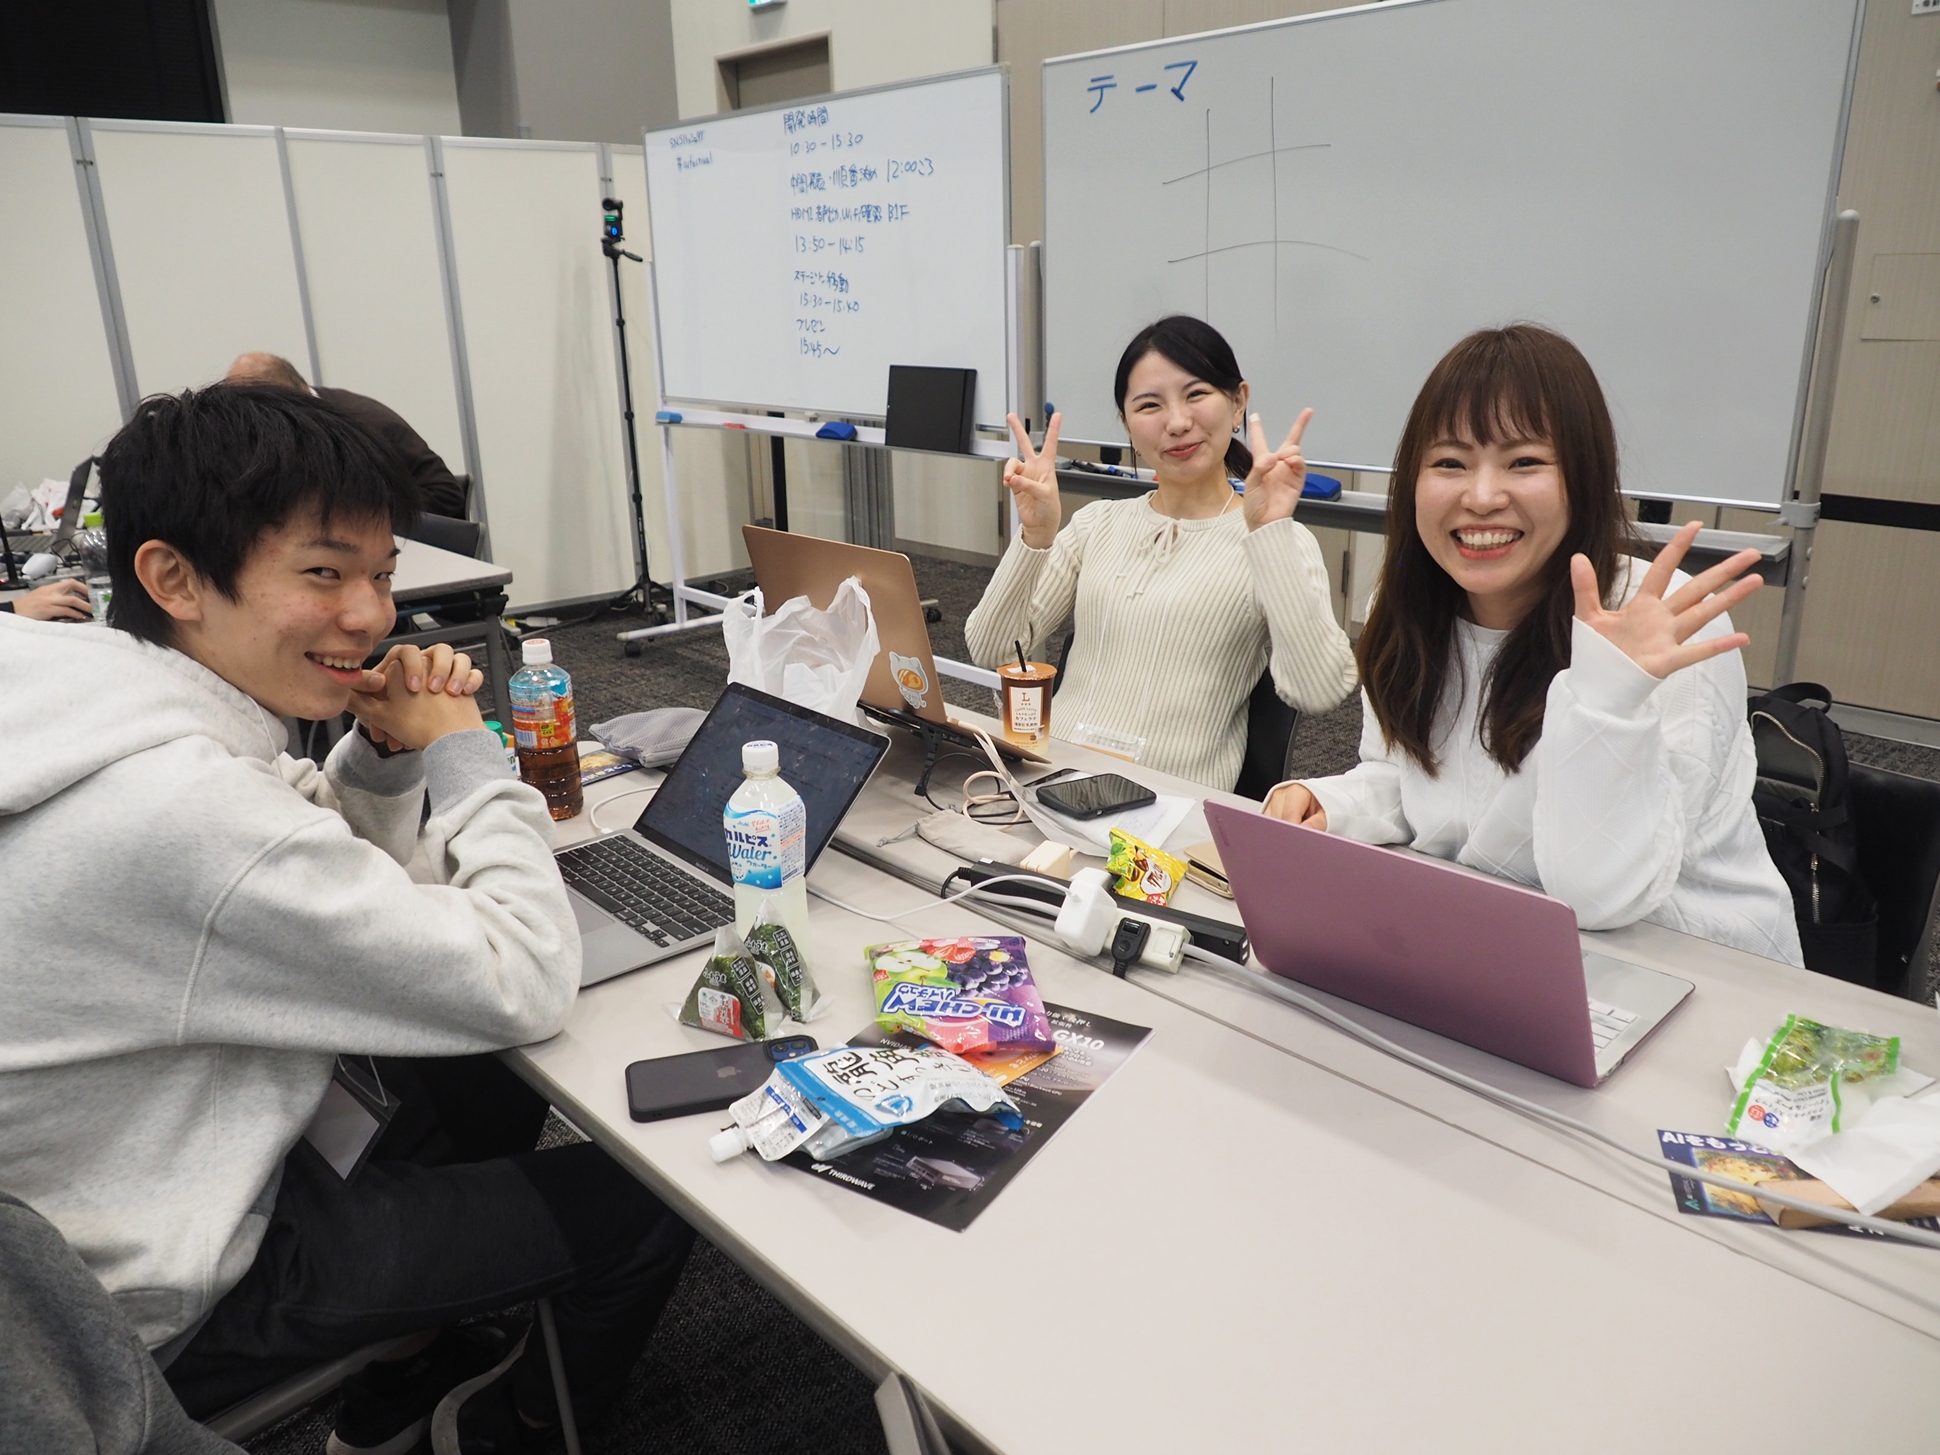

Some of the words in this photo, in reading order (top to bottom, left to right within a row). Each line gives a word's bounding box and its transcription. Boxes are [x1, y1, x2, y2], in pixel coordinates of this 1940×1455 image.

[1087, 60, 1198, 114] テーマ
[783, 106, 829, 134] 開発時間
[724, 827, 769, 847] カルピス
[728, 842, 772, 861] Water
[898, 984, 955, 1000] ハイチュウ
[883, 991, 1027, 1028] HI-CHEW
[1053, 1029, 1105, 1050] GX10
[828, 1169, 876, 1191] THIRDWAVE
